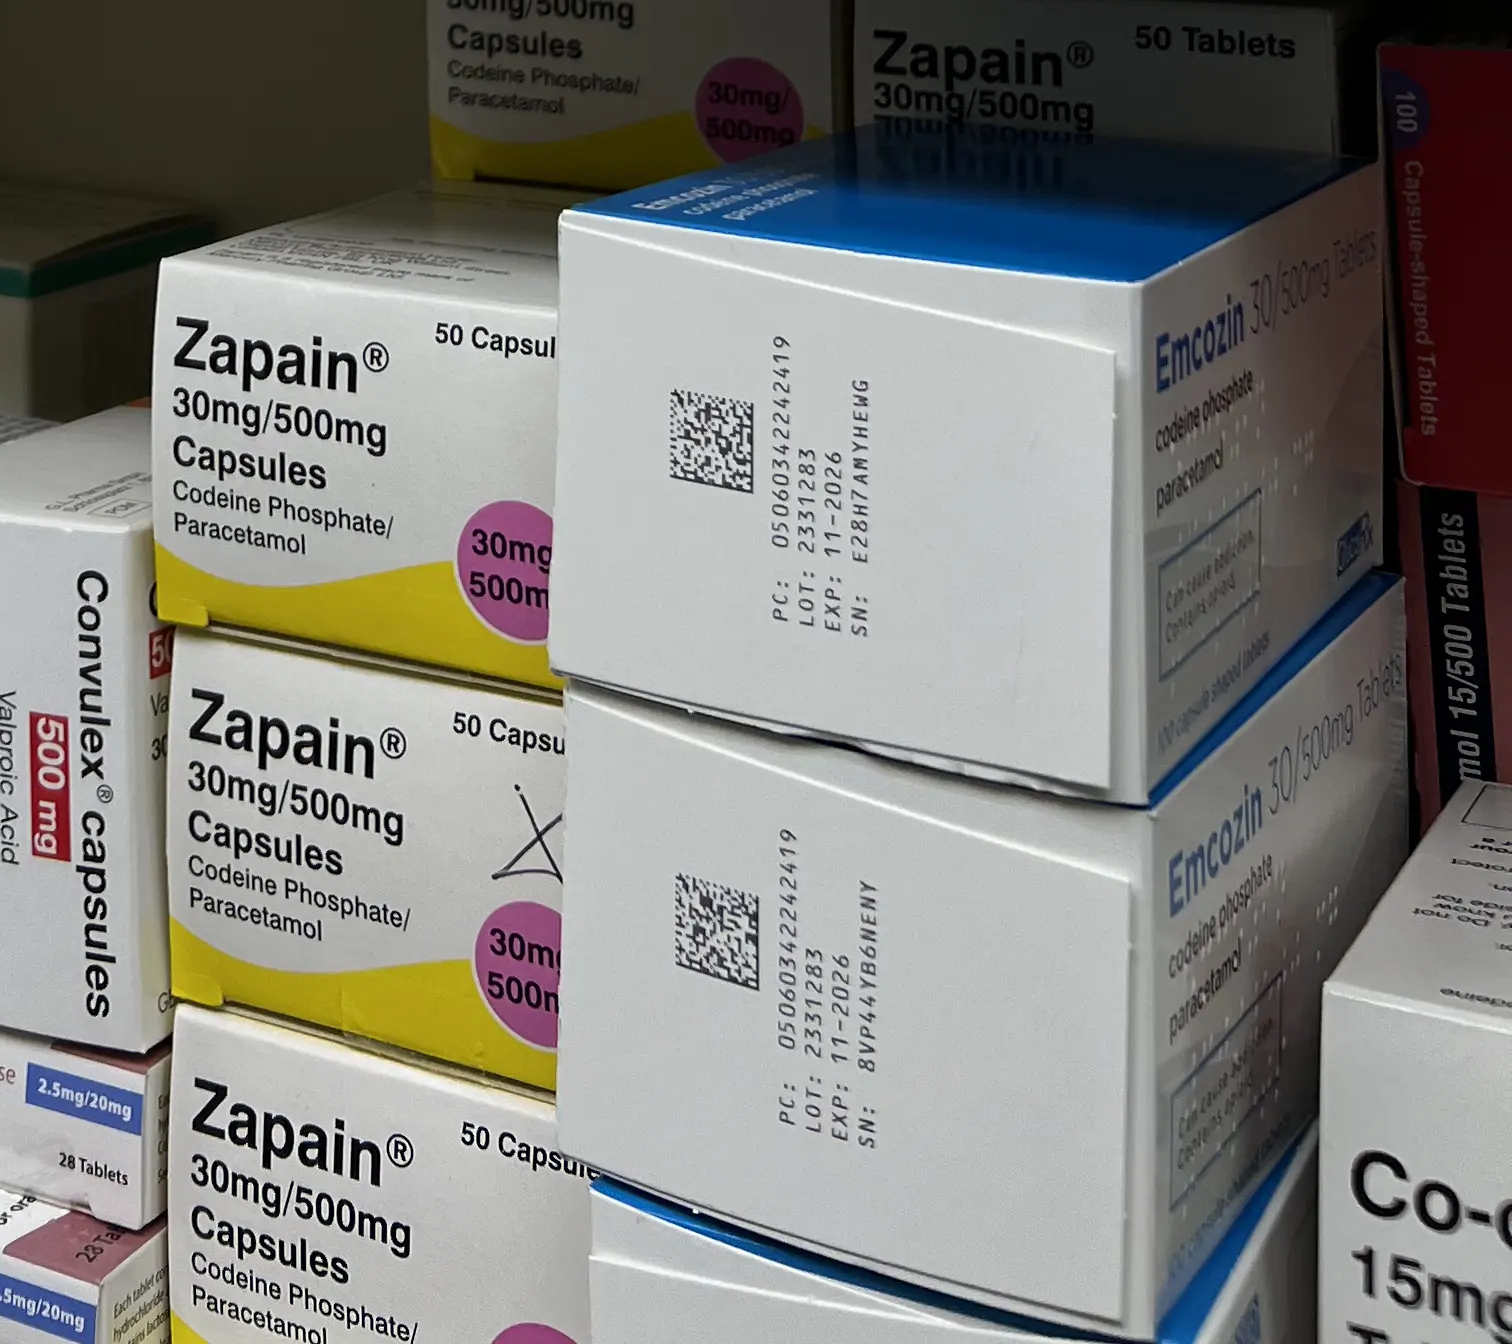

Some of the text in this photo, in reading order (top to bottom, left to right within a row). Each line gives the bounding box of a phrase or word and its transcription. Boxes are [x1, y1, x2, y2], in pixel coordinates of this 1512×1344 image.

[172, 387, 387, 457] 30mg/500mg
[173, 435, 327, 490] Capsules
[771, 336, 791, 621] PC: 05060342242419
[172, 481, 394, 539] Codeine Phosphate/
[174, 513, 307, 555] Paracetamol
[798, 448, 816, 626] LOT: 2331283
[824, 451, 842, 632] EXP: 11-2026
[851, 596, 868, 636] SN:
[35, 717, 65, 856] 500 mg
[0, 801, 19, 865] Acid
[78, 809, 116, 1019] capsules
[37, 1079, 133, 1121] 2.5mg/20mg
[59, 1153, 128, 1186] 28 Tablets
